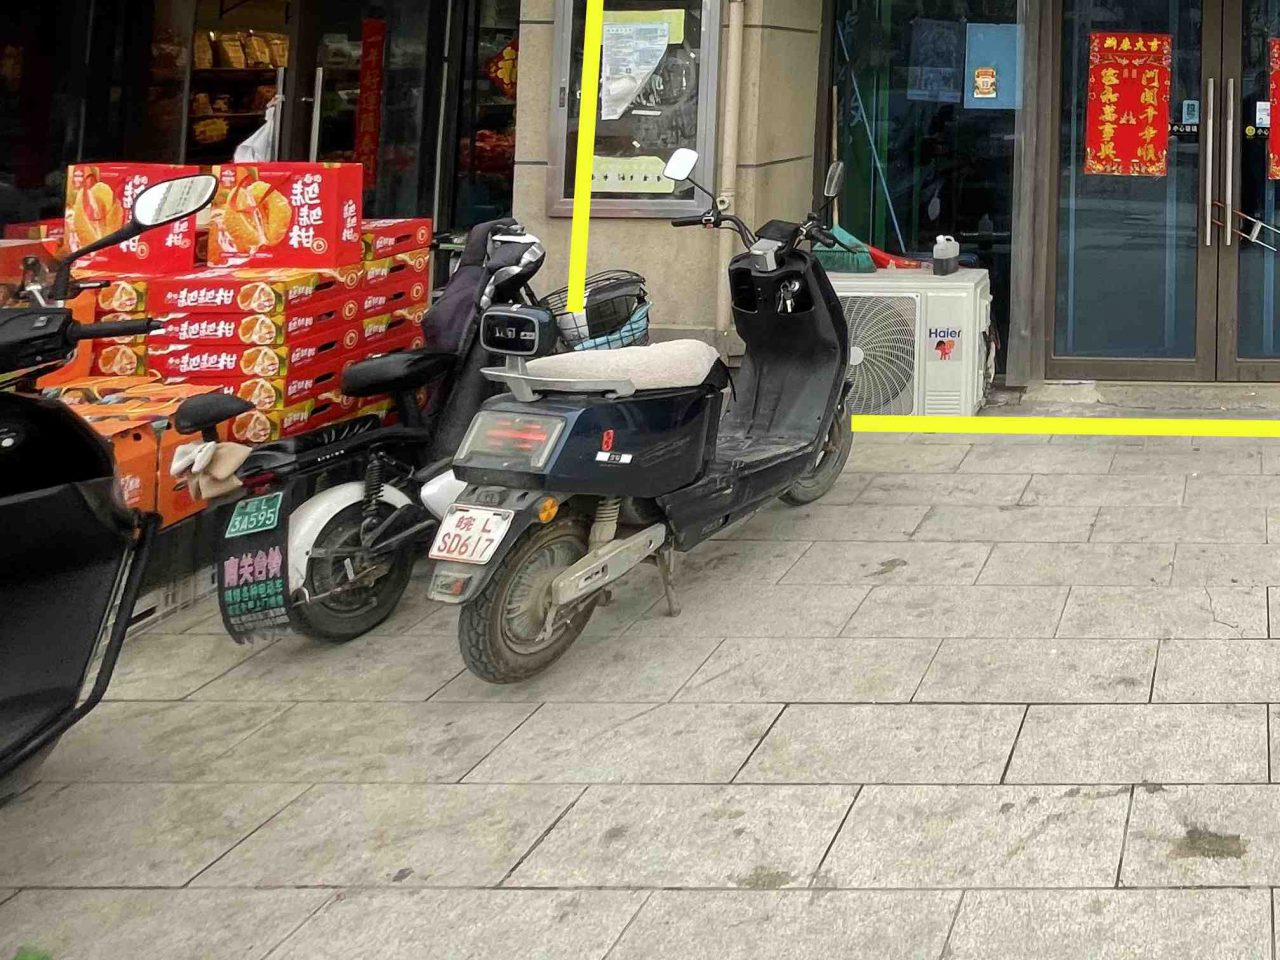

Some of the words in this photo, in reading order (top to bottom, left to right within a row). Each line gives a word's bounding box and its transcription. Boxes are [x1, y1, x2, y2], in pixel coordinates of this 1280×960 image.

[929, 328, 961, 338] Haier
[231, 509, 275, 532] 3A595
[437, 533, 494, 558] SD617
